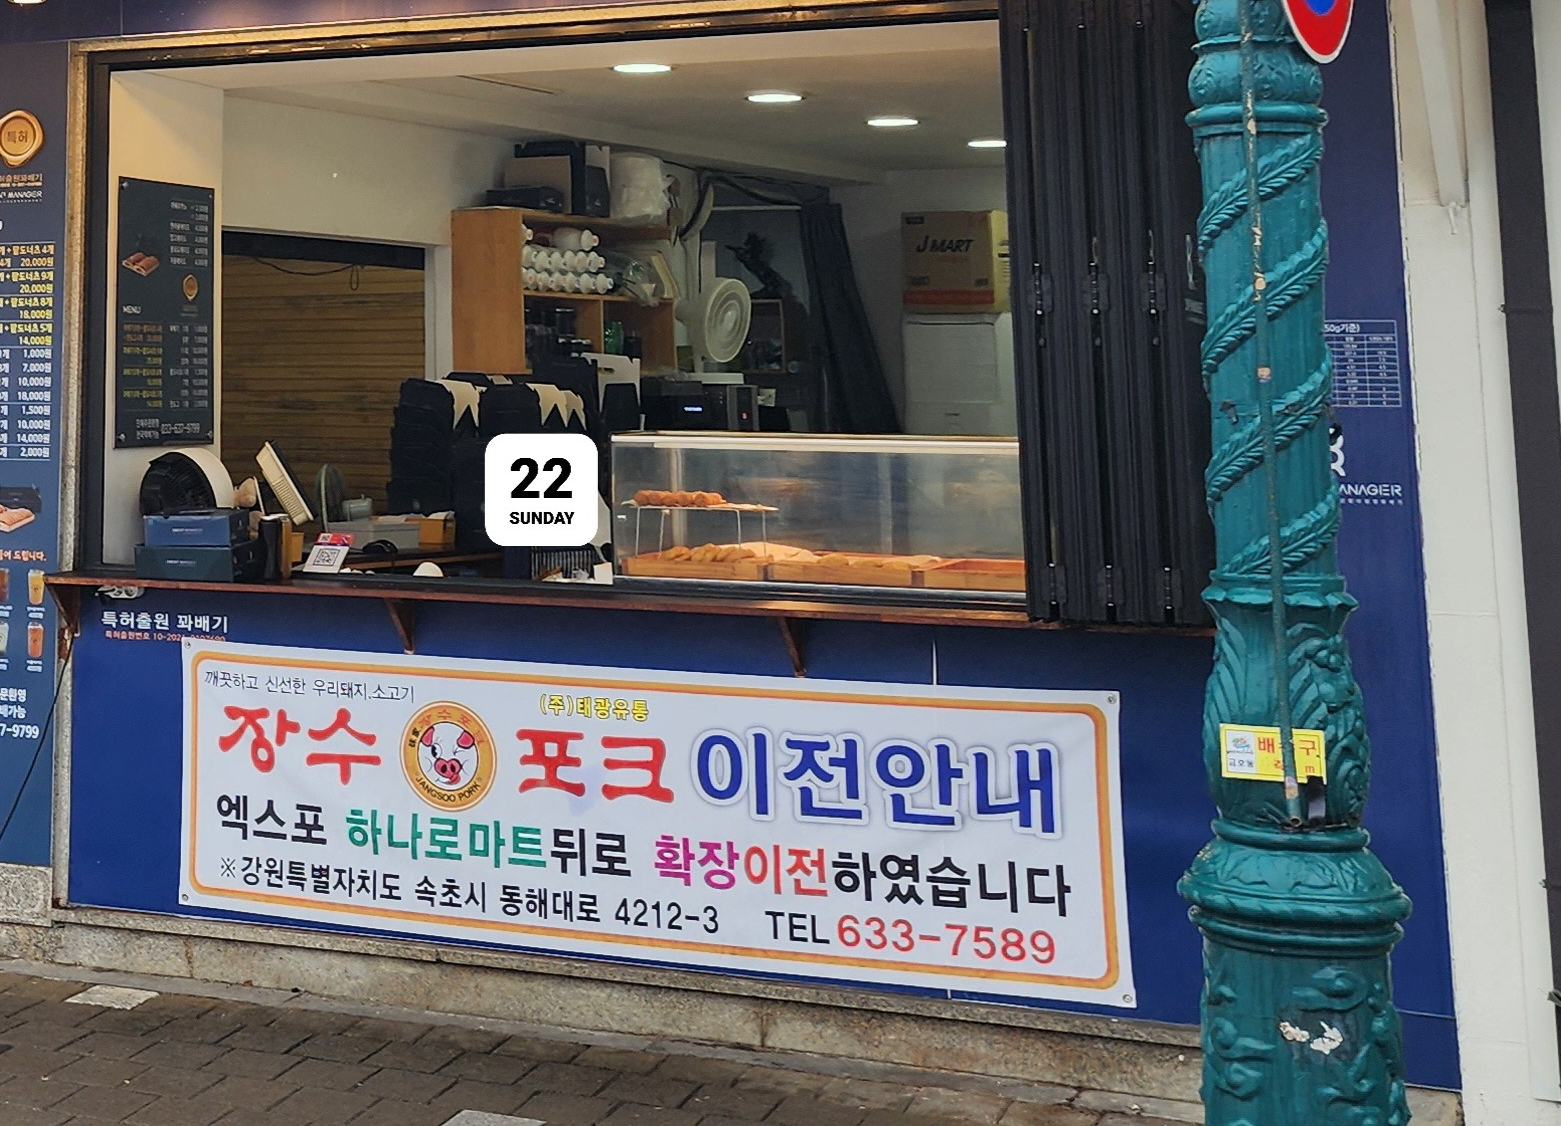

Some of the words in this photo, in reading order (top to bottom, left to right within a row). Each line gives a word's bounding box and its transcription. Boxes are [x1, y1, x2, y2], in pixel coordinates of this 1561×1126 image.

[6, 130, 28, 144] 특허
[101, 611, 170, 631] 특허출원
[176, 614, 228, 633] 꽈배기
[205, 670, 259, 690] 깨끗하고
[265, 675, 307, 695] 신선한
[538, 693, 649, 722] (주)태광유통
[217, 705, 382, 786] 장수
[516, 728, 675, 804] 포크
[697, 732, 1056, 835] 이전안내
[458, 780, 482, 801] PORK
[216, 794, 328, 846] 엑스포
[345, 807, 632, 878] 하나로마트뒤로
[653, 834, 1072, 917] 확장이전하였습니다
[415, 874, 487, 914] 속초시
[499, 884, 601, 925] 동해대로
[615, 897, 719, 933] 4212-3
[836, 913, 1056, 965] 633-7589
